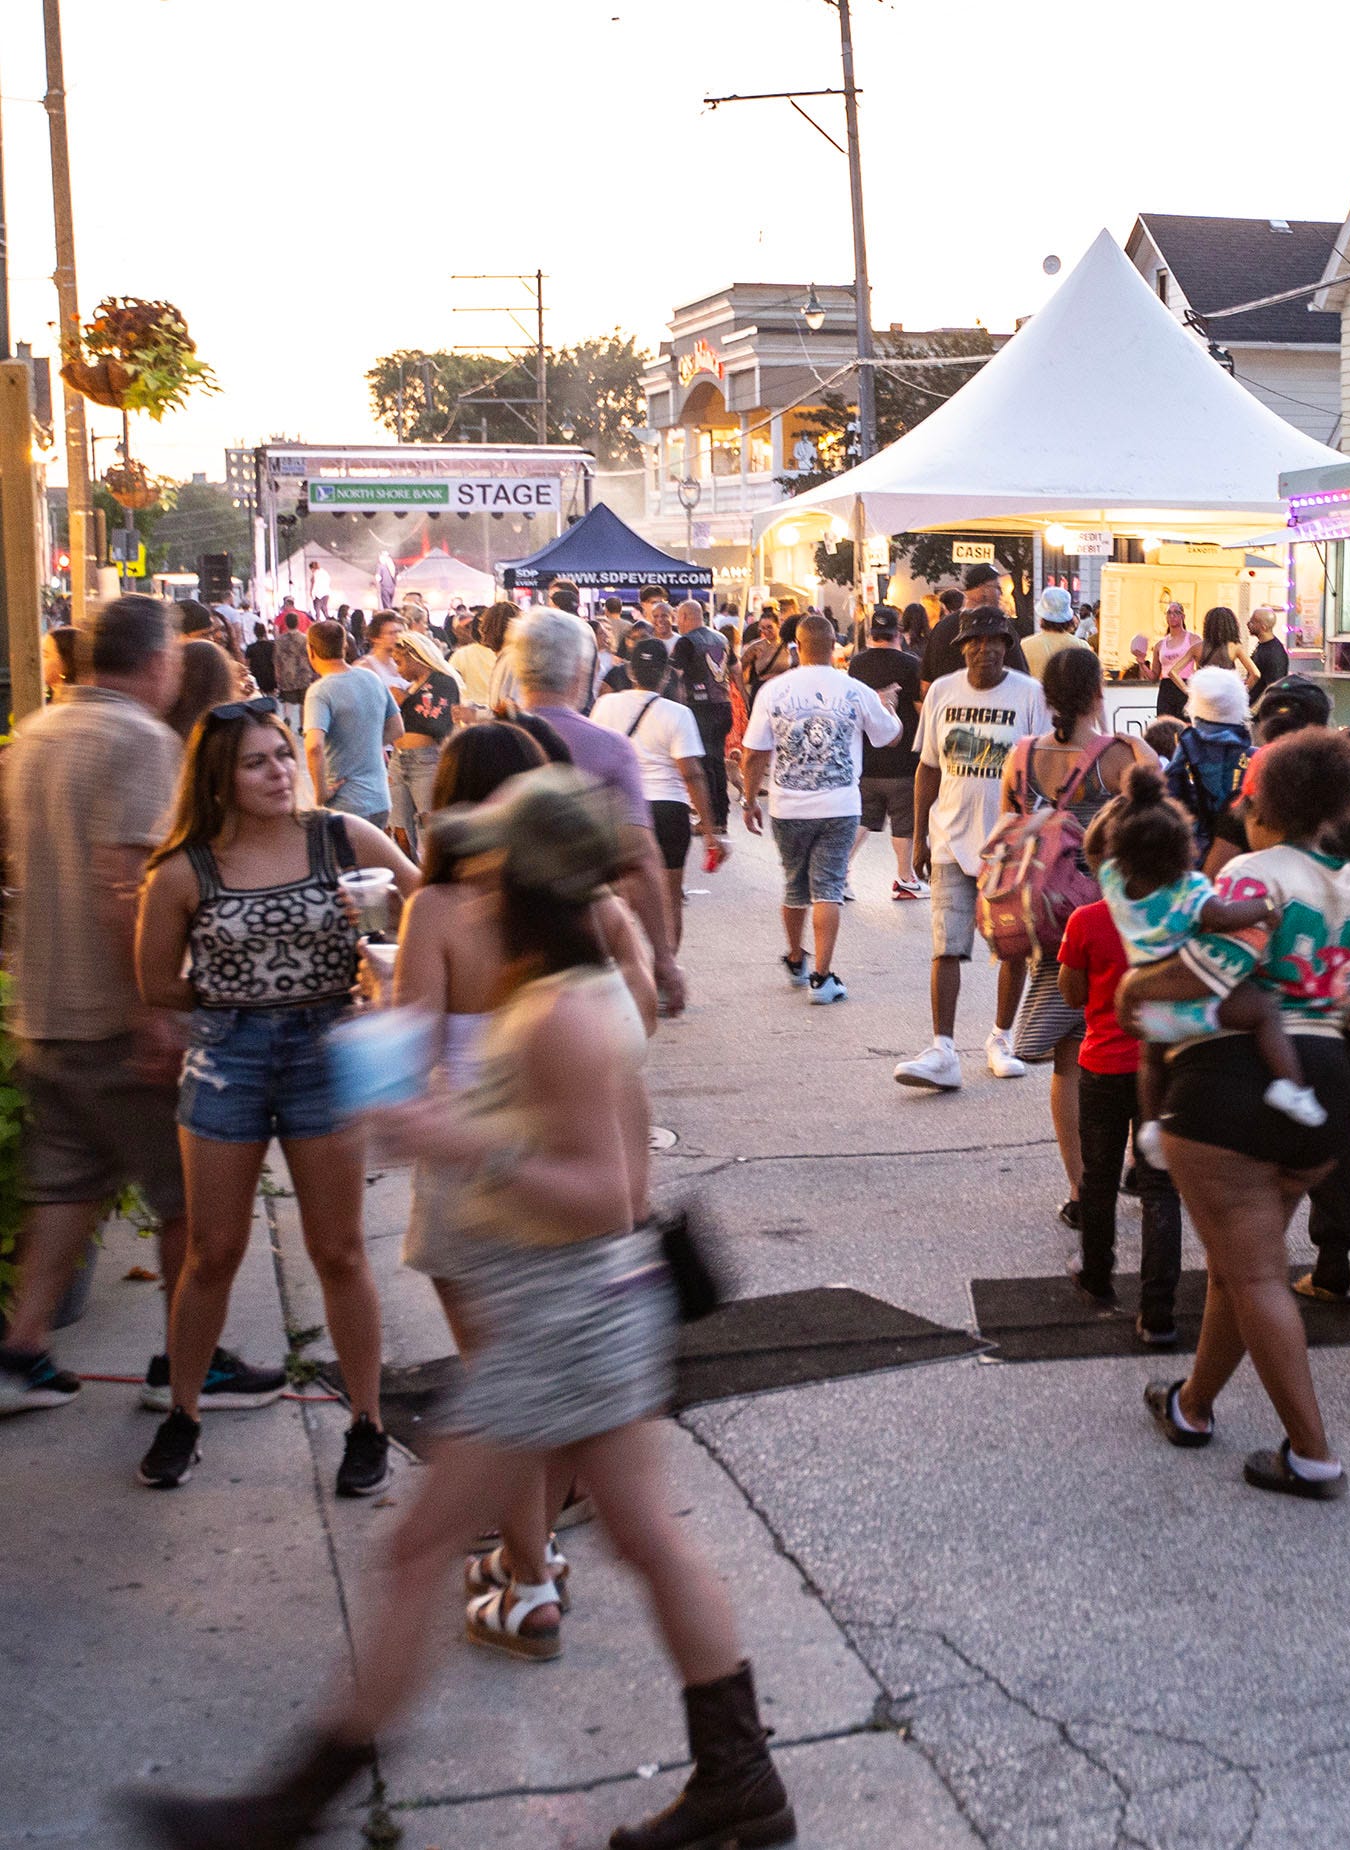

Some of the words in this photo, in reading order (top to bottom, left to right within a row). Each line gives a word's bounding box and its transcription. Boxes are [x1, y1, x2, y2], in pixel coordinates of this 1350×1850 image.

[337, 489, 375, 499] NORTH
[376, 489, 411, 499] SHORE
[413, 489, 443, 500] BANK
[458, 484, 552, 505] STAGE
[956, 545, 991, 559] CASH
[515, 568, 539, 578] SDP
[556, 572, 712, 585] WWW.SDPEVENT.COM
[945, 707, 1016, 727] BERGER
